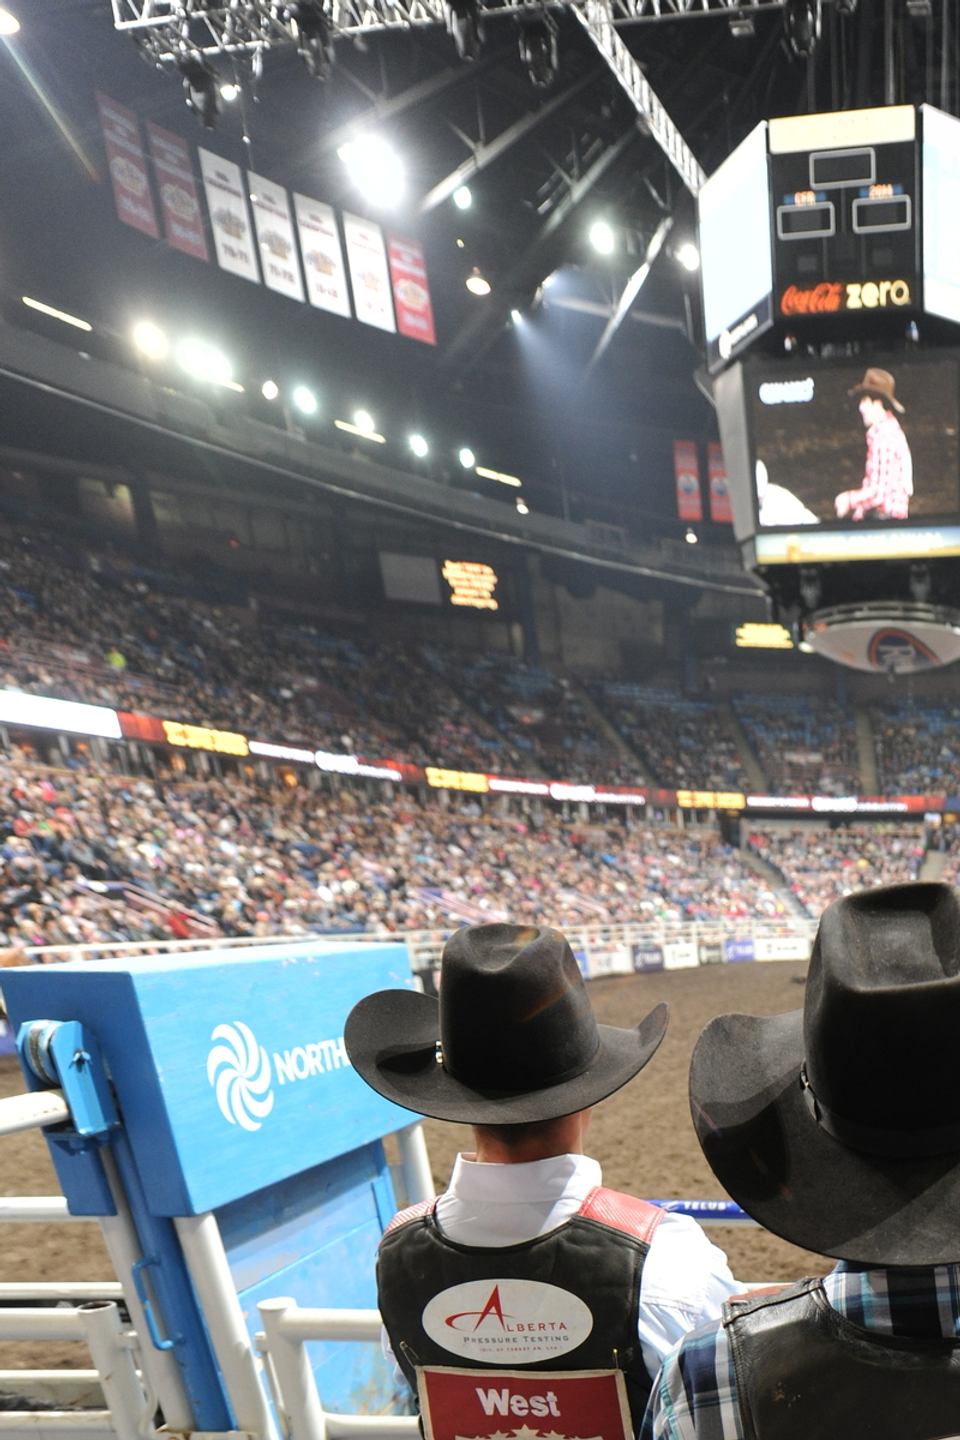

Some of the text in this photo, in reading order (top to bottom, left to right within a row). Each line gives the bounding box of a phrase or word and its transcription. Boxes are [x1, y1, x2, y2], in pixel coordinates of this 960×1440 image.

[846, 280, 910, 309] zero
[473, 1284, 567, 1333] ALBERTA
[463, 1335, 569, 1344] PRESSURE TESTING
[475, 1387, 560, 1417] West
